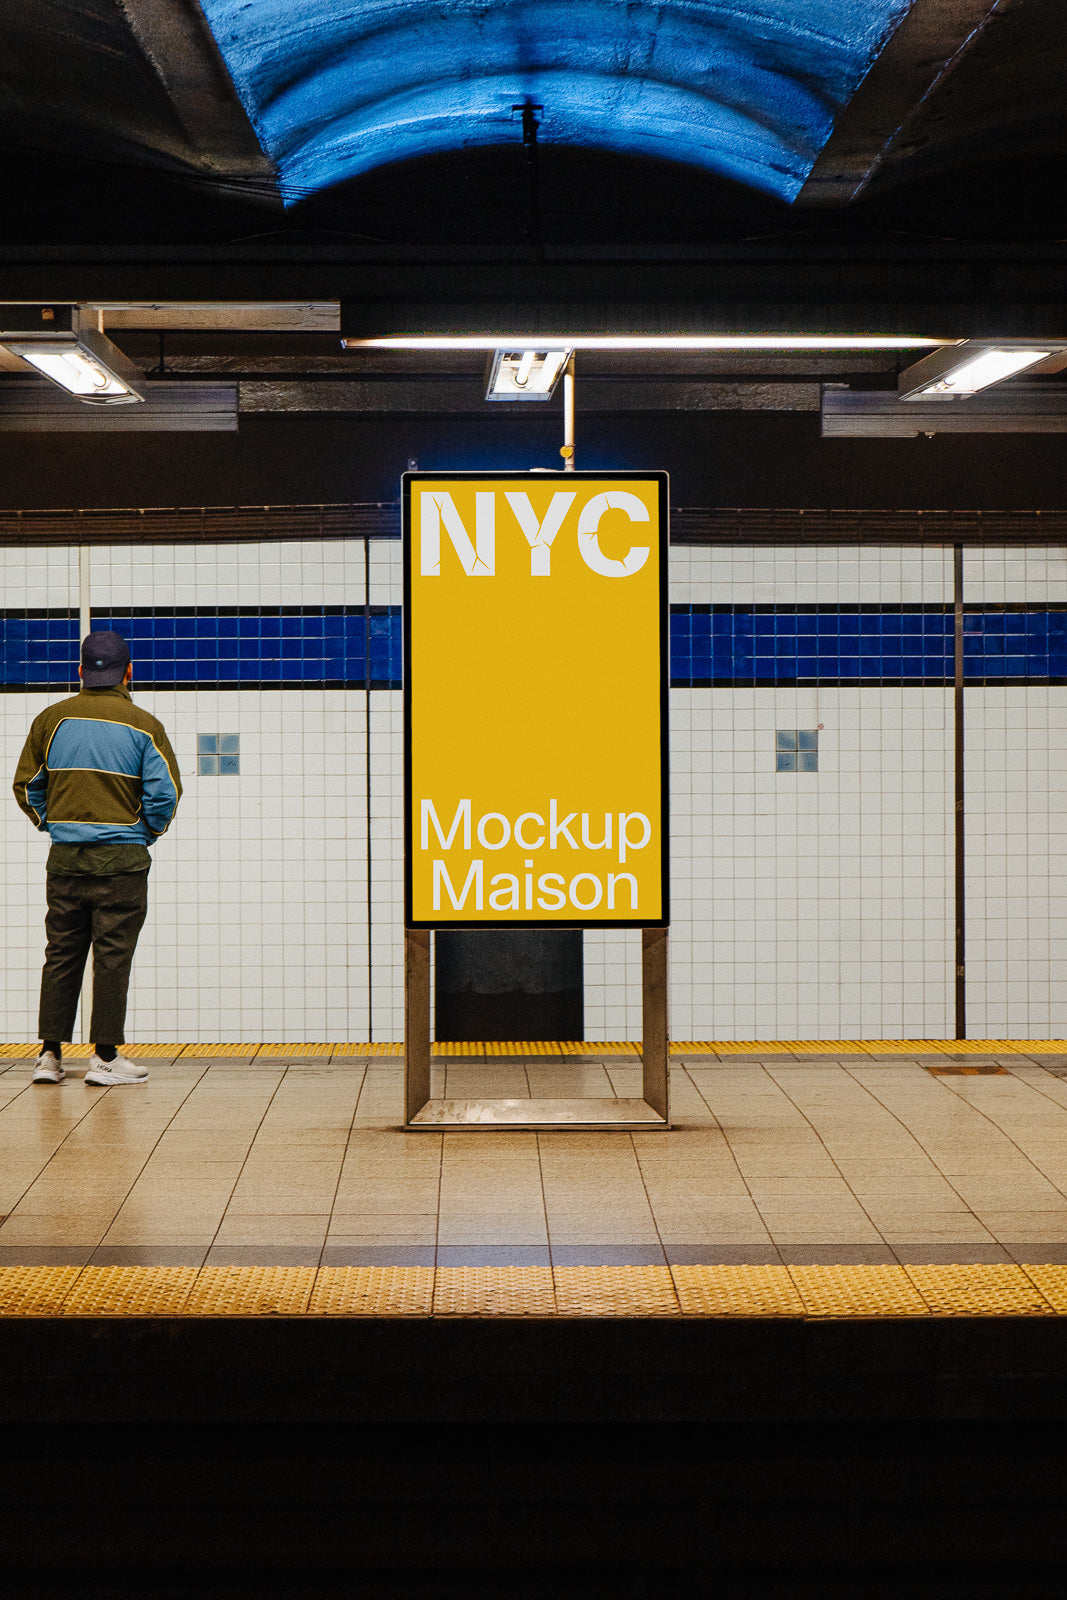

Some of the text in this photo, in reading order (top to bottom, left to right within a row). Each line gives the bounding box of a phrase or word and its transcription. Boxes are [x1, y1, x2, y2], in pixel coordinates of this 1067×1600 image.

[421, 490, 651, 578] NYC
[421, 798, 652, 864] Mockup
[433, 859, 639, 911] Maison
